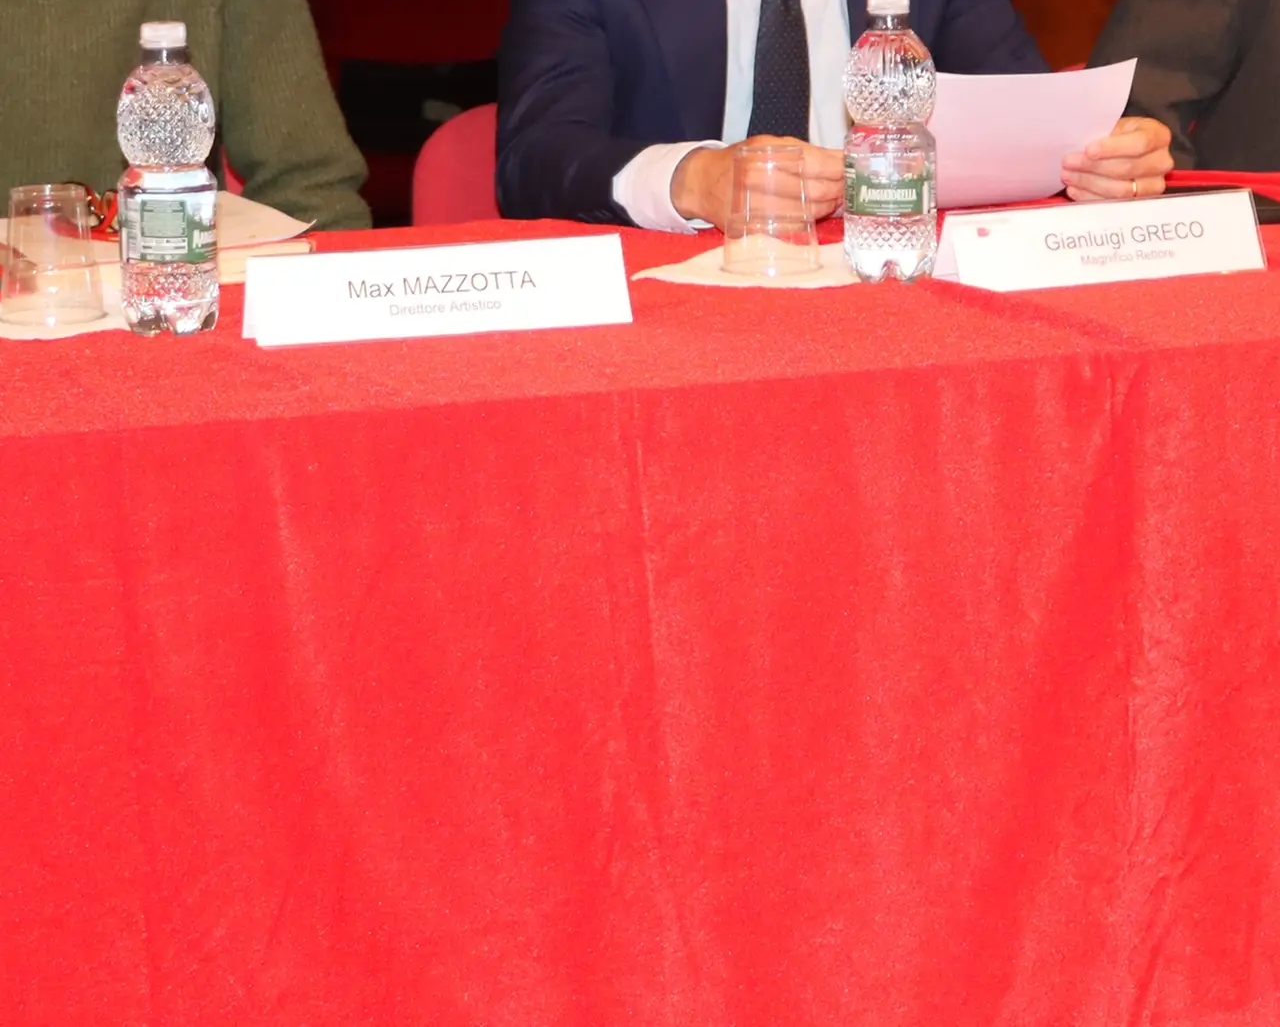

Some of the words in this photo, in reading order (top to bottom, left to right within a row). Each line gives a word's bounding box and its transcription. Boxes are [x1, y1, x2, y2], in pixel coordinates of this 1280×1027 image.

[1045, 227, 1126, 251] Gianluigi
[1130, 220, 1204, 244] GRECO
[1080, 251, 1133, 266] Magnifico
[1136, 249, 1176, 262] Rettore
[348, 279, 396, 299] Max
[402, 270, 537, 296] MAZZOTTA
[389, 302, 445, 316] Direttore
[449, 298, 502, 313] Artistico
